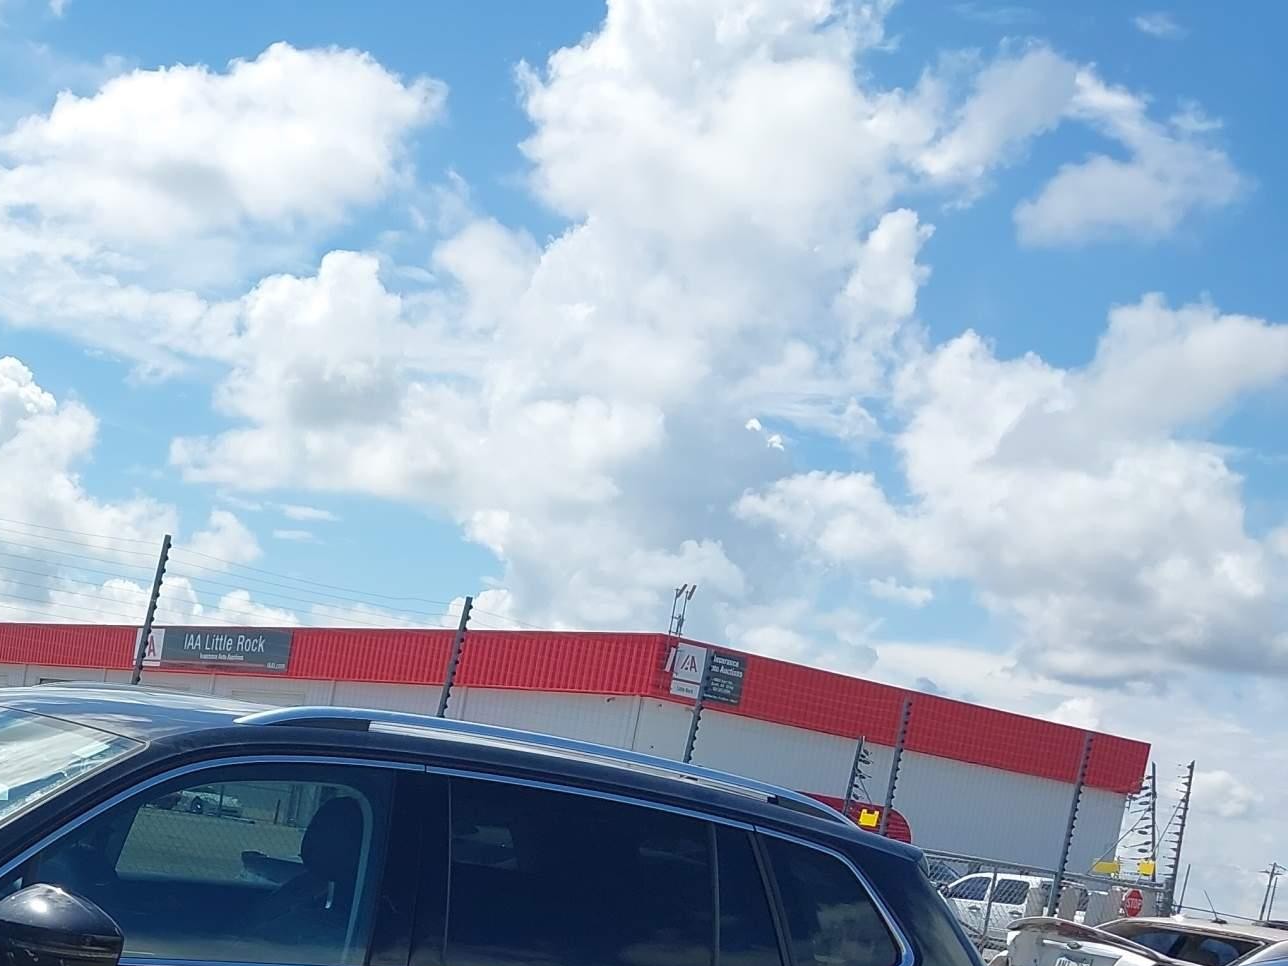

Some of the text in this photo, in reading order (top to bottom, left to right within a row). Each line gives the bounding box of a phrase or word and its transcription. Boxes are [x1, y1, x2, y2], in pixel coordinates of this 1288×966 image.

[184, 633, 266, 653] IAA Little Rock
[713, 655, 740, 668] Insurance
[720, 665, 743, 678] Auctions
[1126, 897, 1142, 910] STOP
